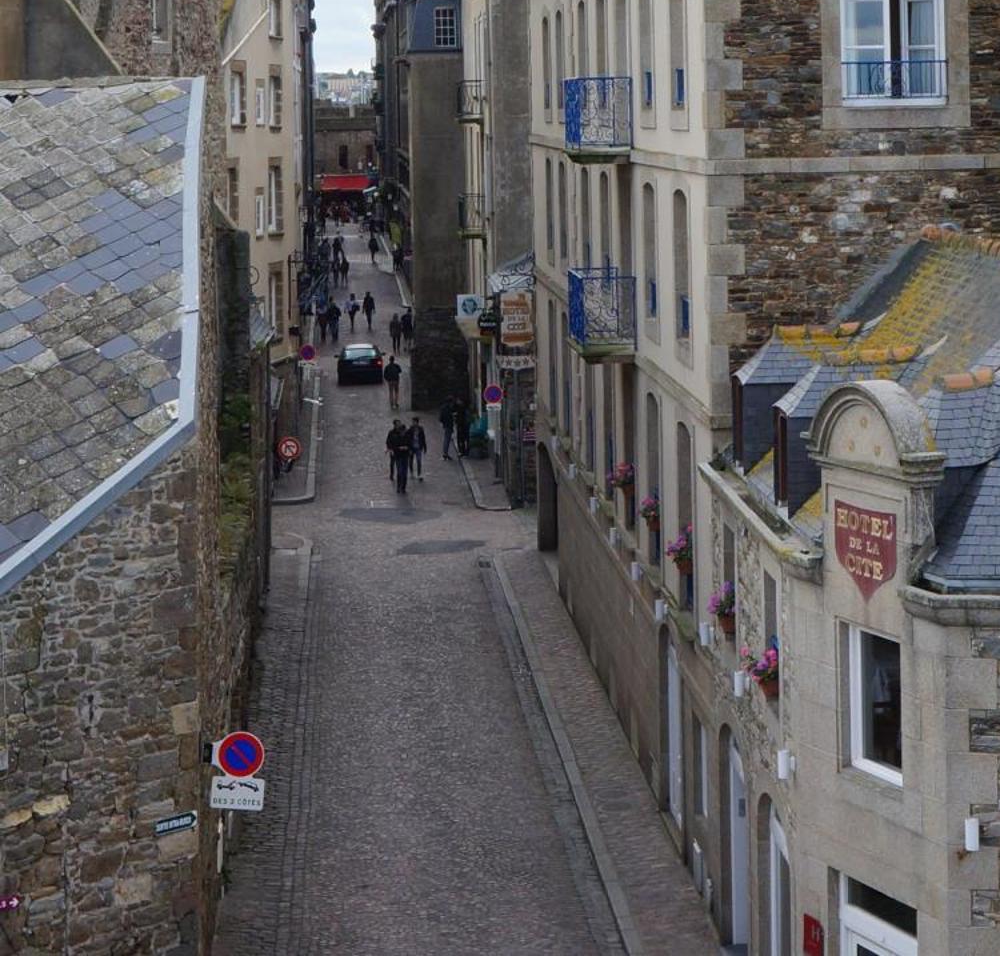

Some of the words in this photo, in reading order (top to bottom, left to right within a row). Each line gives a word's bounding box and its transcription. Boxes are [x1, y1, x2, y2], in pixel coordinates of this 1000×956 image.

[836, 507, 894, 541] HOTEL
[848, 536, 862, 550] DE
[866, 541, 880, 555] LA
[845, 553, 884, 581] CITE
